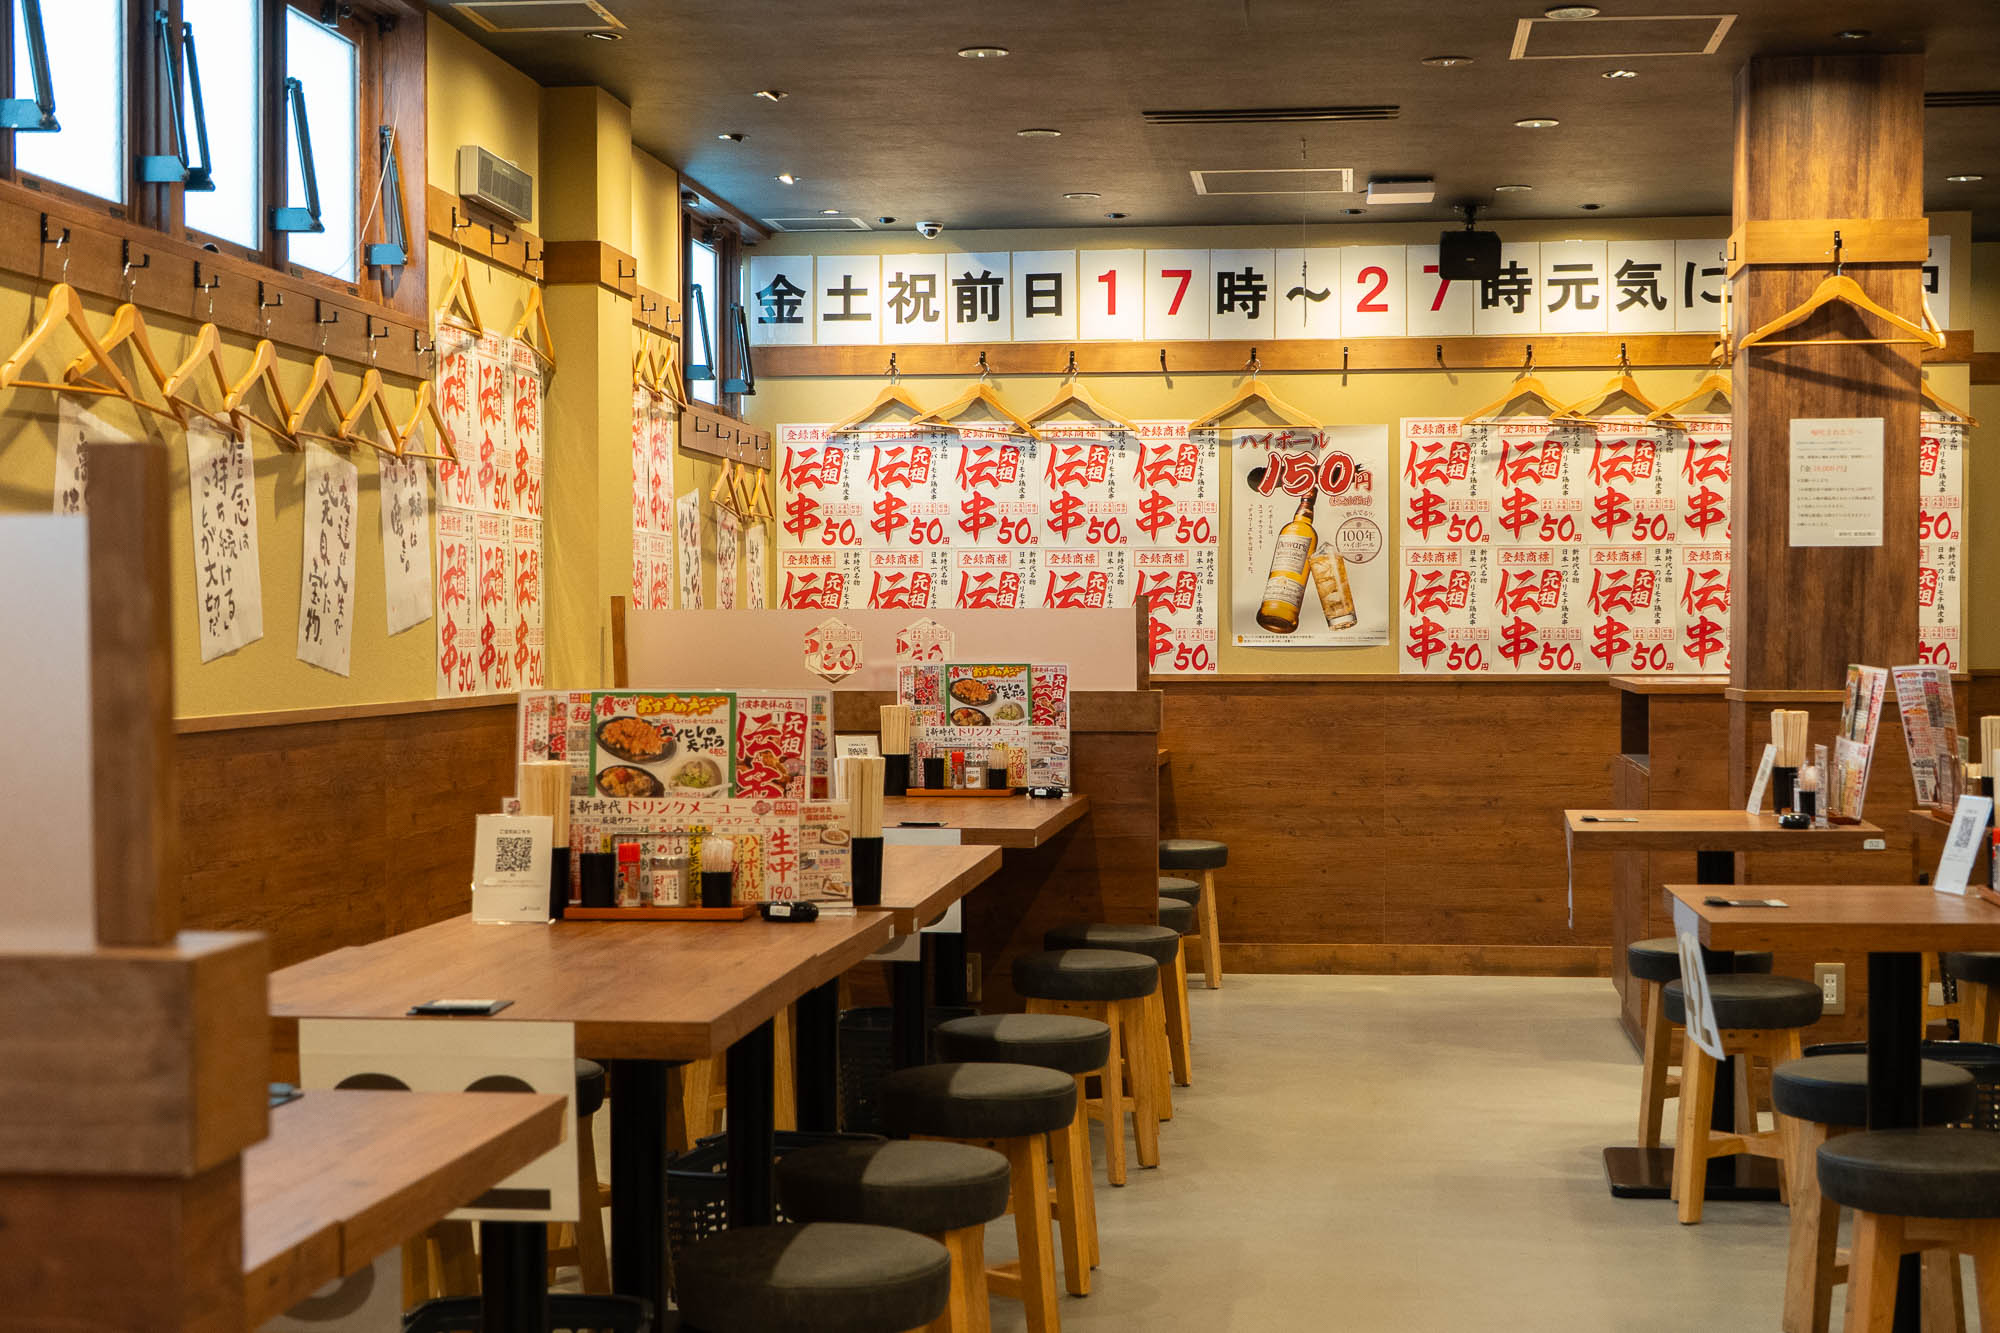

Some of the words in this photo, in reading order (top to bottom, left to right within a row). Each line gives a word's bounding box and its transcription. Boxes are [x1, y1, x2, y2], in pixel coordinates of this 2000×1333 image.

[1239, 431, 1331, 451] ハイボール
[821, 450, 842, 483] 元祖
[909, 449, 929, 481] 元祖
[997, 448, 1018, 481] 元祖
[1086, 447, 1107, 481] 元祖
[1176, 446, 1197, 480] 元祖
[1257, 451, 1372, 497] 150円
[1447, 445, 1469, 479] 元祖
[1539, 444, 1561, 478] 元祖
[1632, 443, 1654, 477] 元祖
[779, 446, 824, 544] 伝串
[867, 445, 911, 542] 伝串
[955, 444, 1000, 542] 伝串
[1043, 443, 1089, 543] 伝串
[1132, 442, 1178, 542] 伝串
[1404, 441, 1450, 542] 伝串
[1496, 440, 1542, 541] 伝串
[1589, 439, 1635, 540] 伝串
[1682, 438, 1728, 539] 伝串
[821, 516, 862, 545] 50円
[909, 514, 949, 543] 50円
[997, 514, 1038, 543] 50円
[1086, 514, 1128, 544] 50円
[1176, 514, 1218, 544] 50円
[1342, 530, 1376, 542] 100年
[1447, 514, 1490, 544] 50円
[1539, 513, 1582, 543] 50円
[1632, 512, 1675, 542] 50円
[822, 575, 842, 607] 元祖
[909, 574, 930, 607] 元祖
[997, 574, 1018, 607] 元祖
[1085, 574, 1106, 607] 元祖
[1175, 573, 1196, 607] 元祖
[1447, 572, 1468, 606] 元祖
[1539, 572, 1560, 606] 元祖
[1631, 572, 1653, 606] 元祖
[1131, 569, 1177, 669] 伝串
[1404, 568, 1450, 669] 伝串
[1495, 568, 1541, 668] 伝串
[1588, 568, 1634, 669] 伝串
[1681, 568, 1727, 669] 伝串
[1175, 642, 1217, 671] 50円
[1447, 642, 1490, 671] 50円
[1539, 641, 1581, 670] 50円
[1631, 642, 1674, 671] 50円
[1052, 676, 1065, 700] 元祖
[637, 695, 728, 716] おすすめメニュー
[782, 714, 804, 753] 元祖
[958, 727, 1029, 737] ドリンクメニュー
[578, 800, 622, 815] 新時代
[628, 800, 747, 815] ドリンクメニュー
[744, 836, 759, 890] ハイボール
[770, 827, 794, 884] 生中
